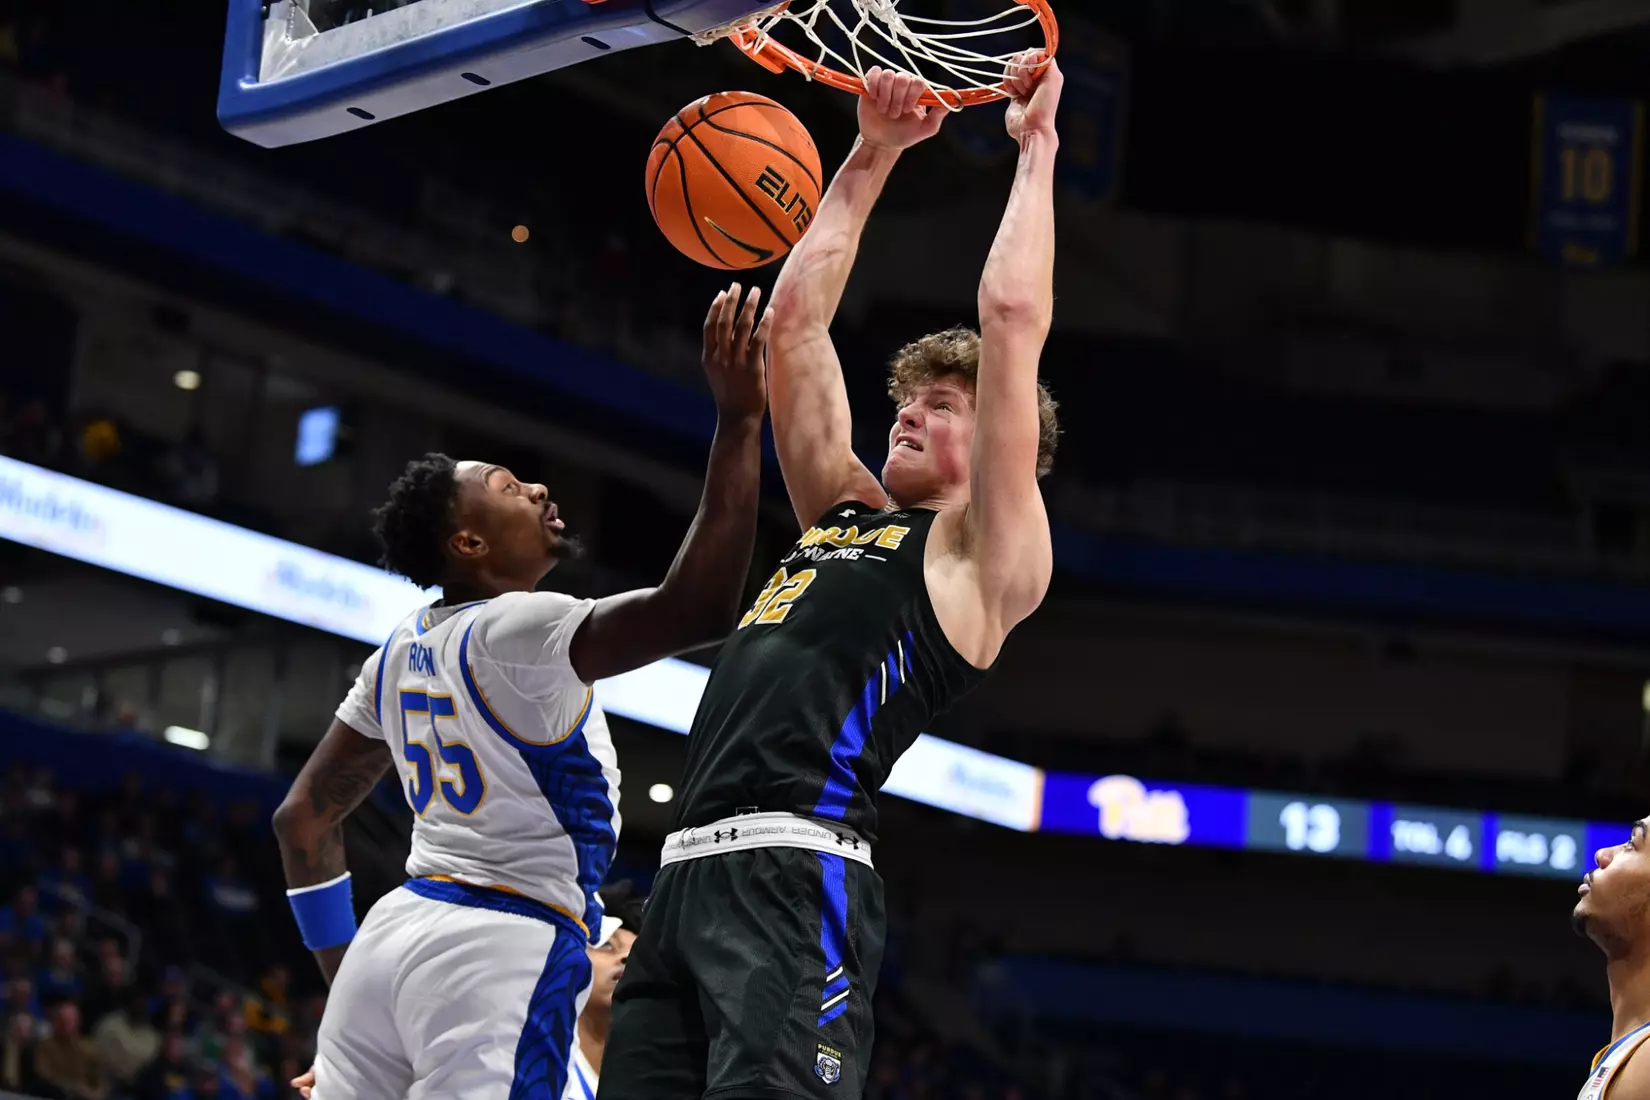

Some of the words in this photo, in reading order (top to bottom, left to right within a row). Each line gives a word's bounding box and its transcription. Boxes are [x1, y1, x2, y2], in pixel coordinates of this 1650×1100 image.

[754, 165, 813, 233] ELITE
[737, 566, 817, 630] 32
[399, 687, 488, 819] 55
[741, 826, 787, 837] ARMOUR
[791, 827, 832, 840] UNDER
[1279, 801, 1341, 852] 13
[1445, 824, 1473, 861] 4
